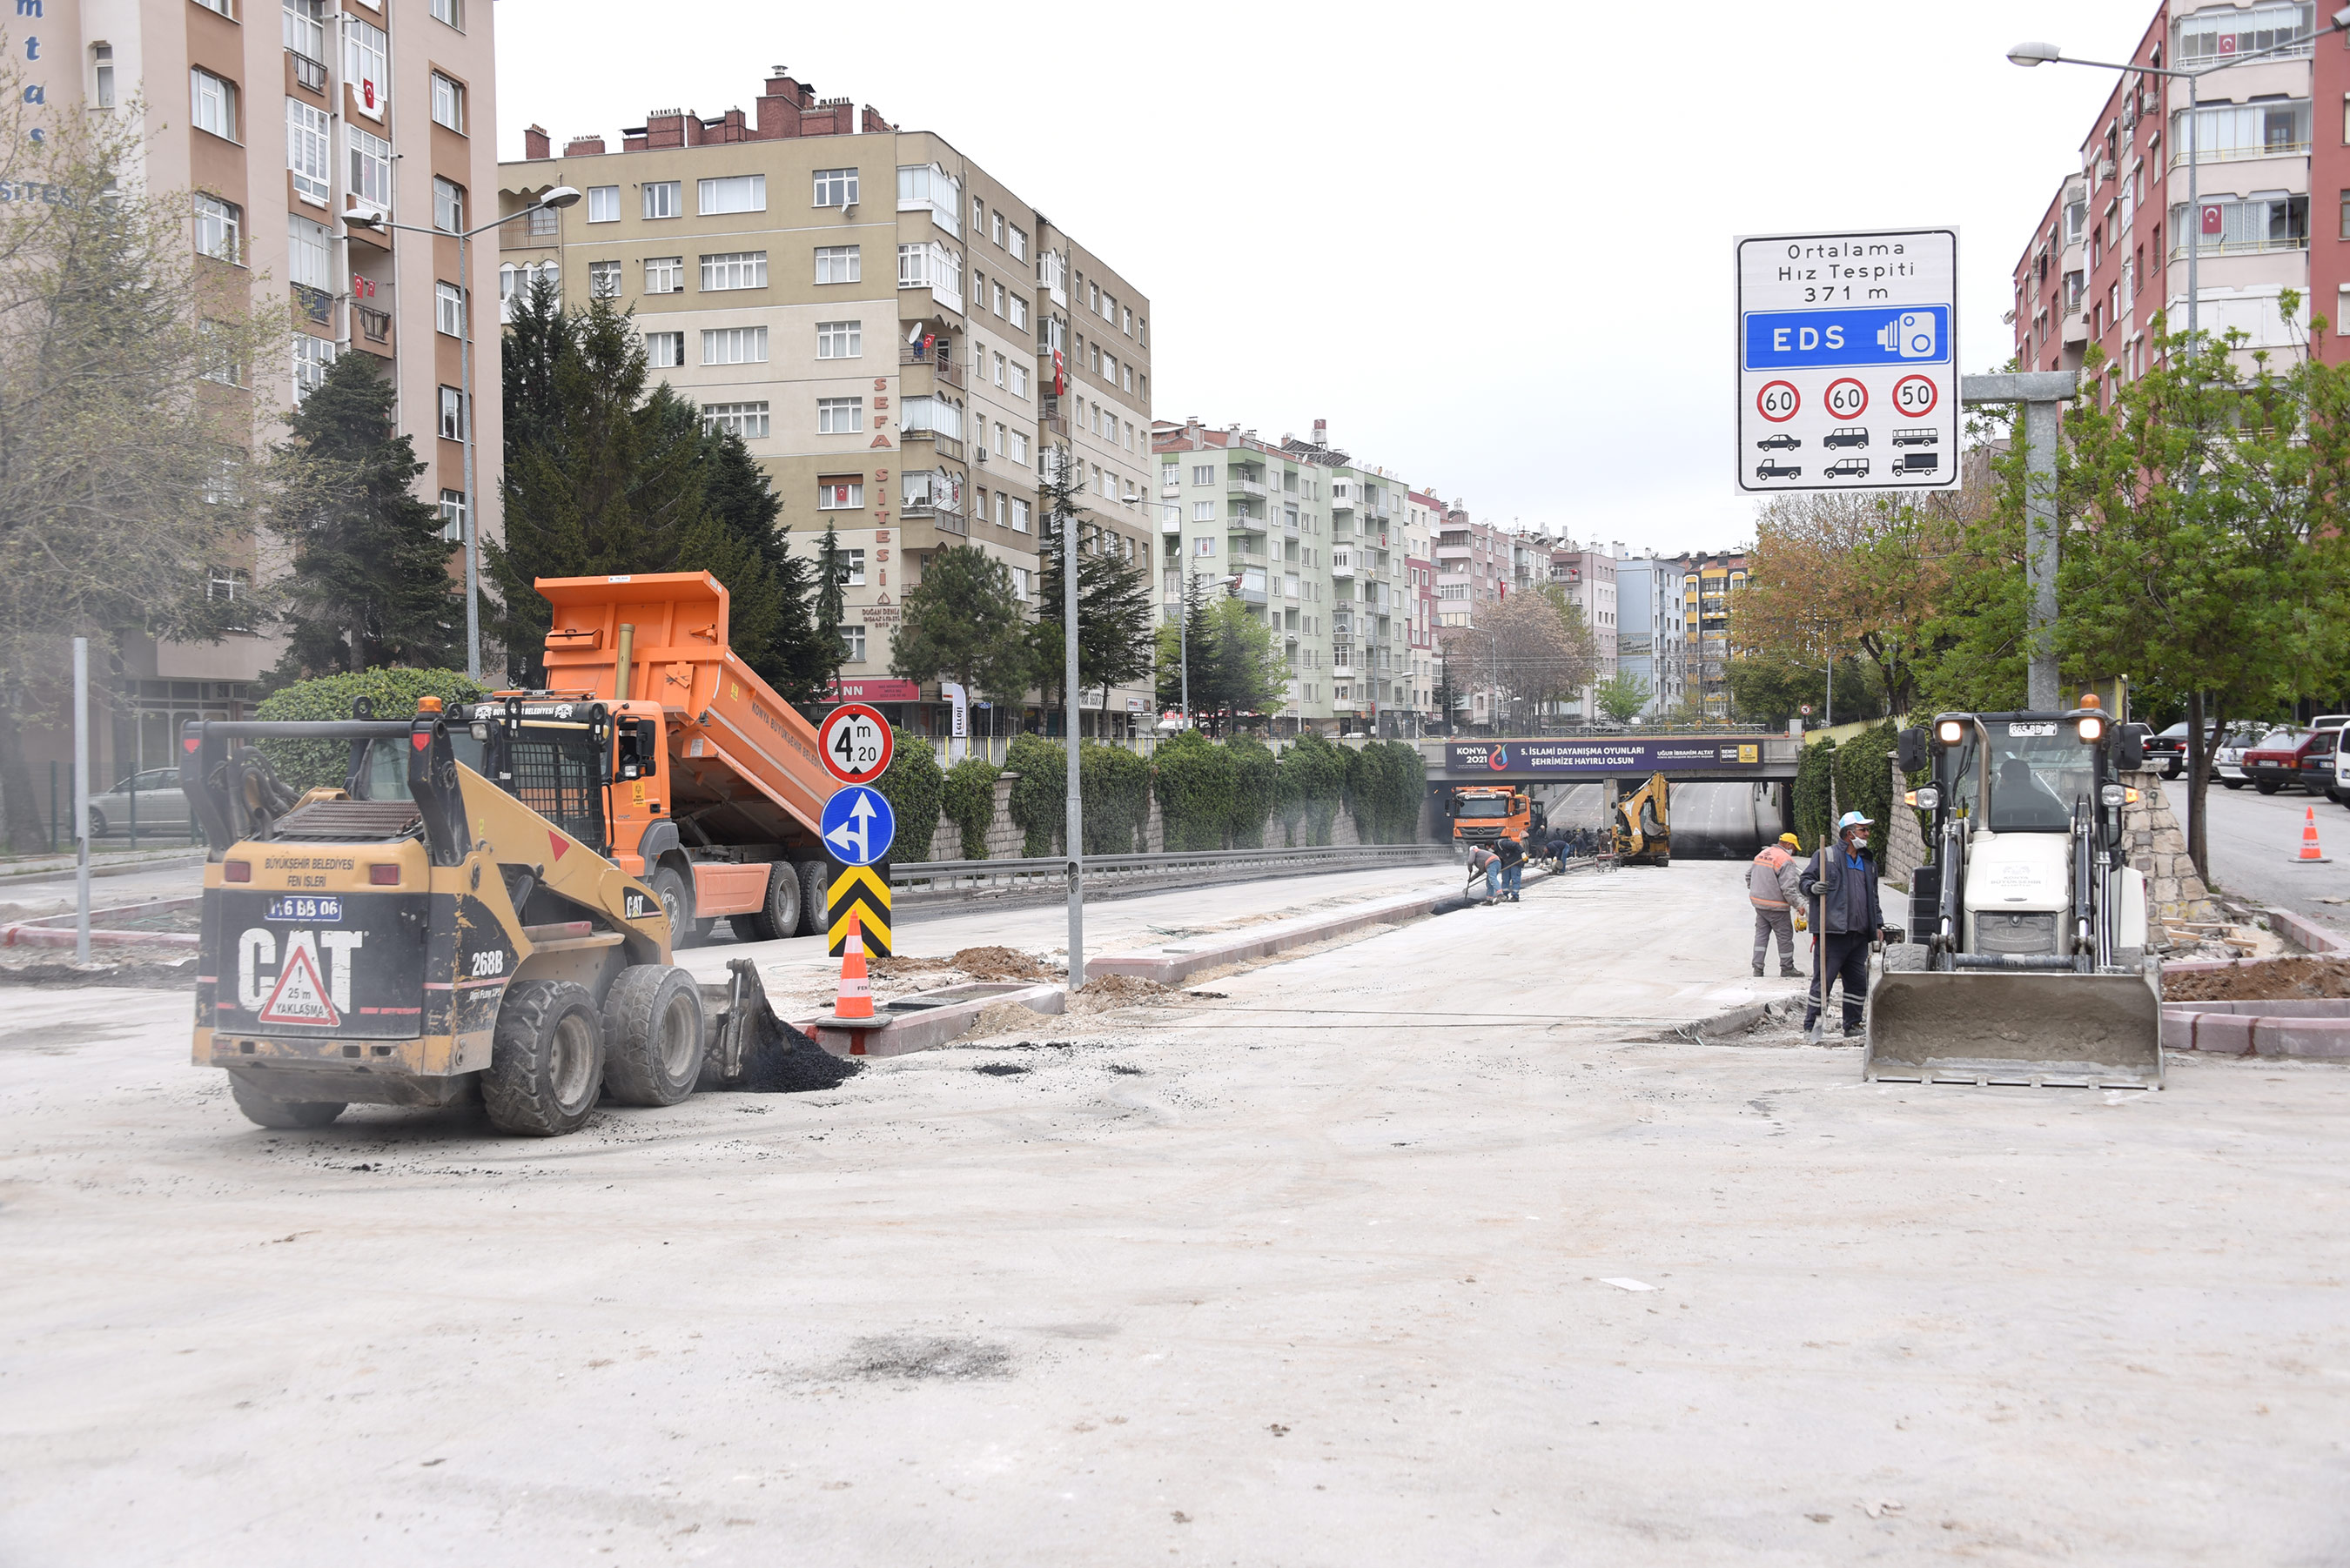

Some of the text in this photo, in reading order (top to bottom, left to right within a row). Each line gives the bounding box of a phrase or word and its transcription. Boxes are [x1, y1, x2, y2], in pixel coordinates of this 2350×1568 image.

[1788, 242, 1905, 259] Ortalama
[1778, 262, 1915, 282] Hız Tespiti
[1804, 285, 1889, 303] 371 m
[1773, 325, 1845, 352] EDS
[1765, 385, 1930, 412] 60 60 50
[870, 378, 892, 448] SEFA
[874, 468, 891, 586] SİTESİ
[751, 701, 769, 724] KONYA
[856, 725, 870, 738] m
[1456, 747, 1487, 755] KONYA
[1528, 747, 1555, 755] İSLAMİ
[1556, 747, 1602, 757] DAYANIŞMA
[1602, 747, 1644, 755] OYUNLARI
[1531, 756, 1574, 767] ŞEHRİMİZE
[265, 855, 355, 871] BÜYÜKŞEHİR BELEDİYESİ
[286, 874, 326, 888] FEN İŞLERİ
[319, 901, 339, 915] 06
[627, 895, 644, 918] CAT
[238, 928, 363, 1015] CAT
[472, 950, 503, 976] 268B
[288, 988, 311, 999] 25 m
[276, 1003, 324, 1015] YAKLAŞMA
